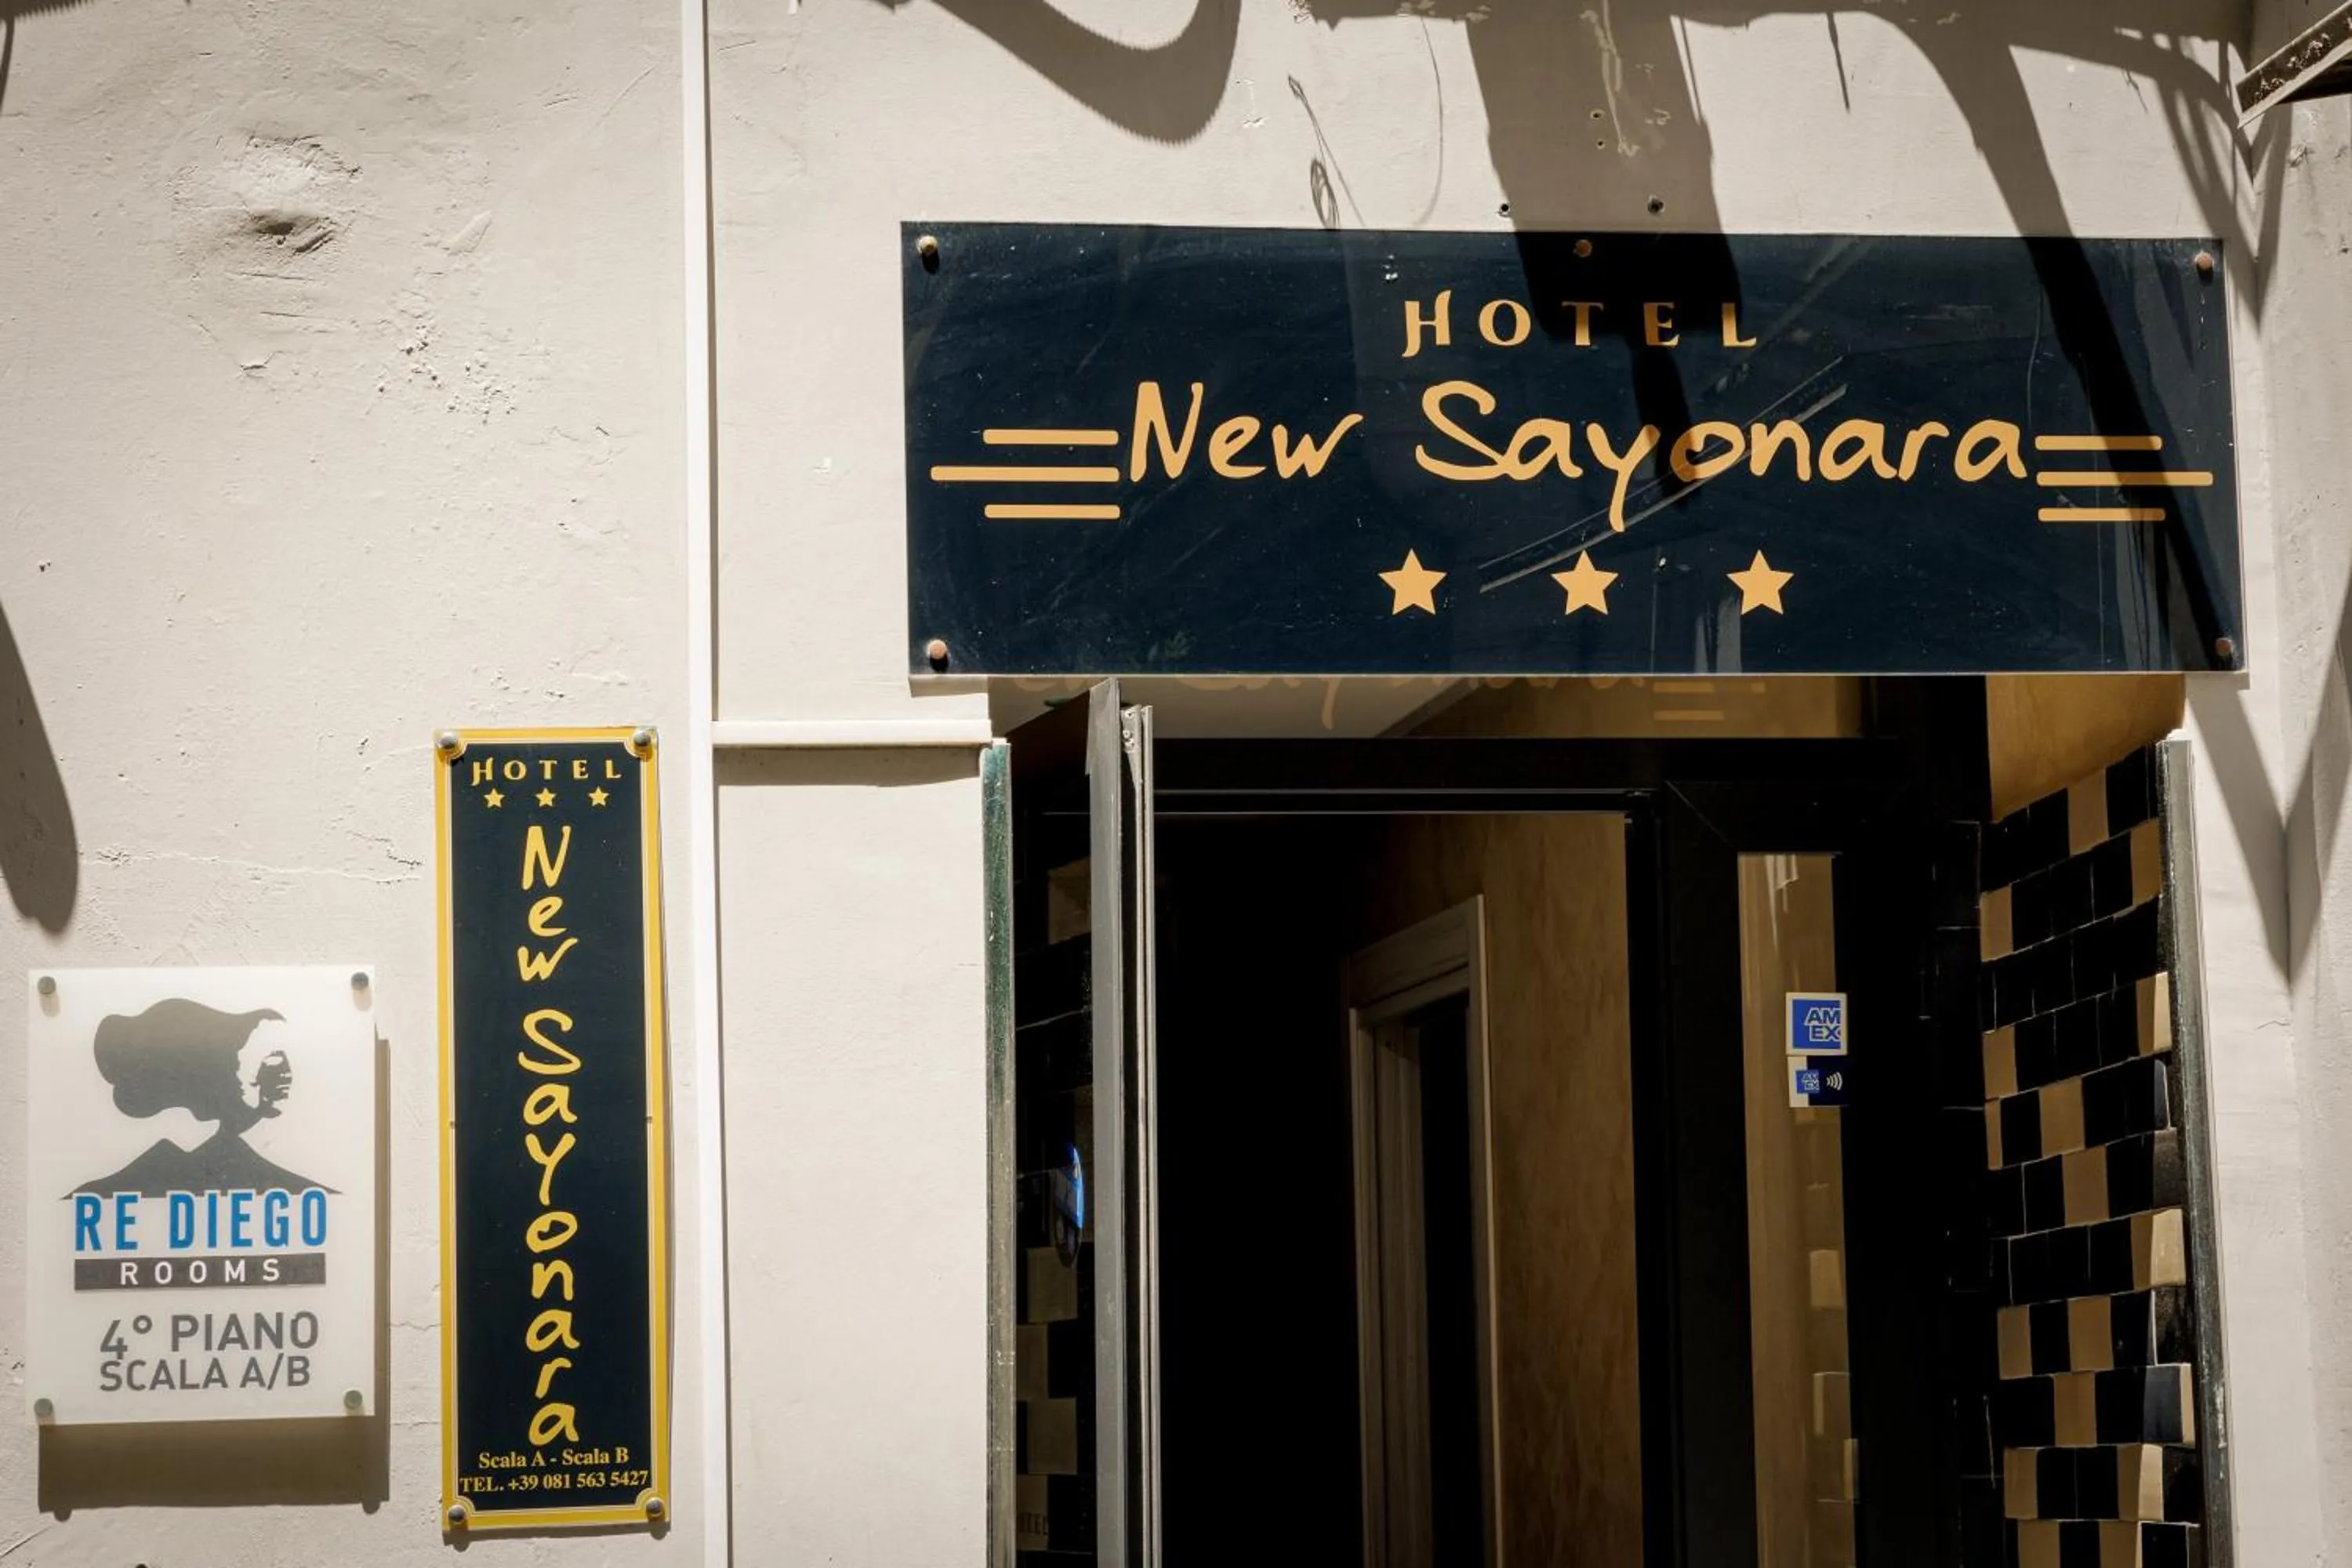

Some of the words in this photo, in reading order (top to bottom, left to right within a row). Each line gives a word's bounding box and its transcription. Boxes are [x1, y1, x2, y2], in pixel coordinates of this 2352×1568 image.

[1403, 289, 1756, 358] HOTEL
[1129, 380, 1363, 483] New
[1414, 379, 2027, 533] Sayonara
[471, 757, 622, 786] HOTEL
[517, 825, 578, 982] New
[74, 1193, 140, 1251] RE
[168, 1189, 327, 1250] DIEGO
[517, 1008, 582, 1446] Sayonara
[120, 1258, 280, 1286] ROOMS
[171, 1311, 319, 1352] PIANO
[100, 1359, 229, 1392] SCALA
[239, 1352, 310, 1390] A/B
[478, 1450, 527, 1468] Scala
[531, 1450, 546, 1468] A
[562, 1448, 610, 1466] Scala
[615, 1446, 630, 1465] B
[459, 1475, 505, 1493] TEL.
[508, 1474, 539, 1490] +39
[543, 1473, 571, 1489] 081
[576, 1472, 606, 1488] 563
[610, 1469, 649, 1486] 5427
